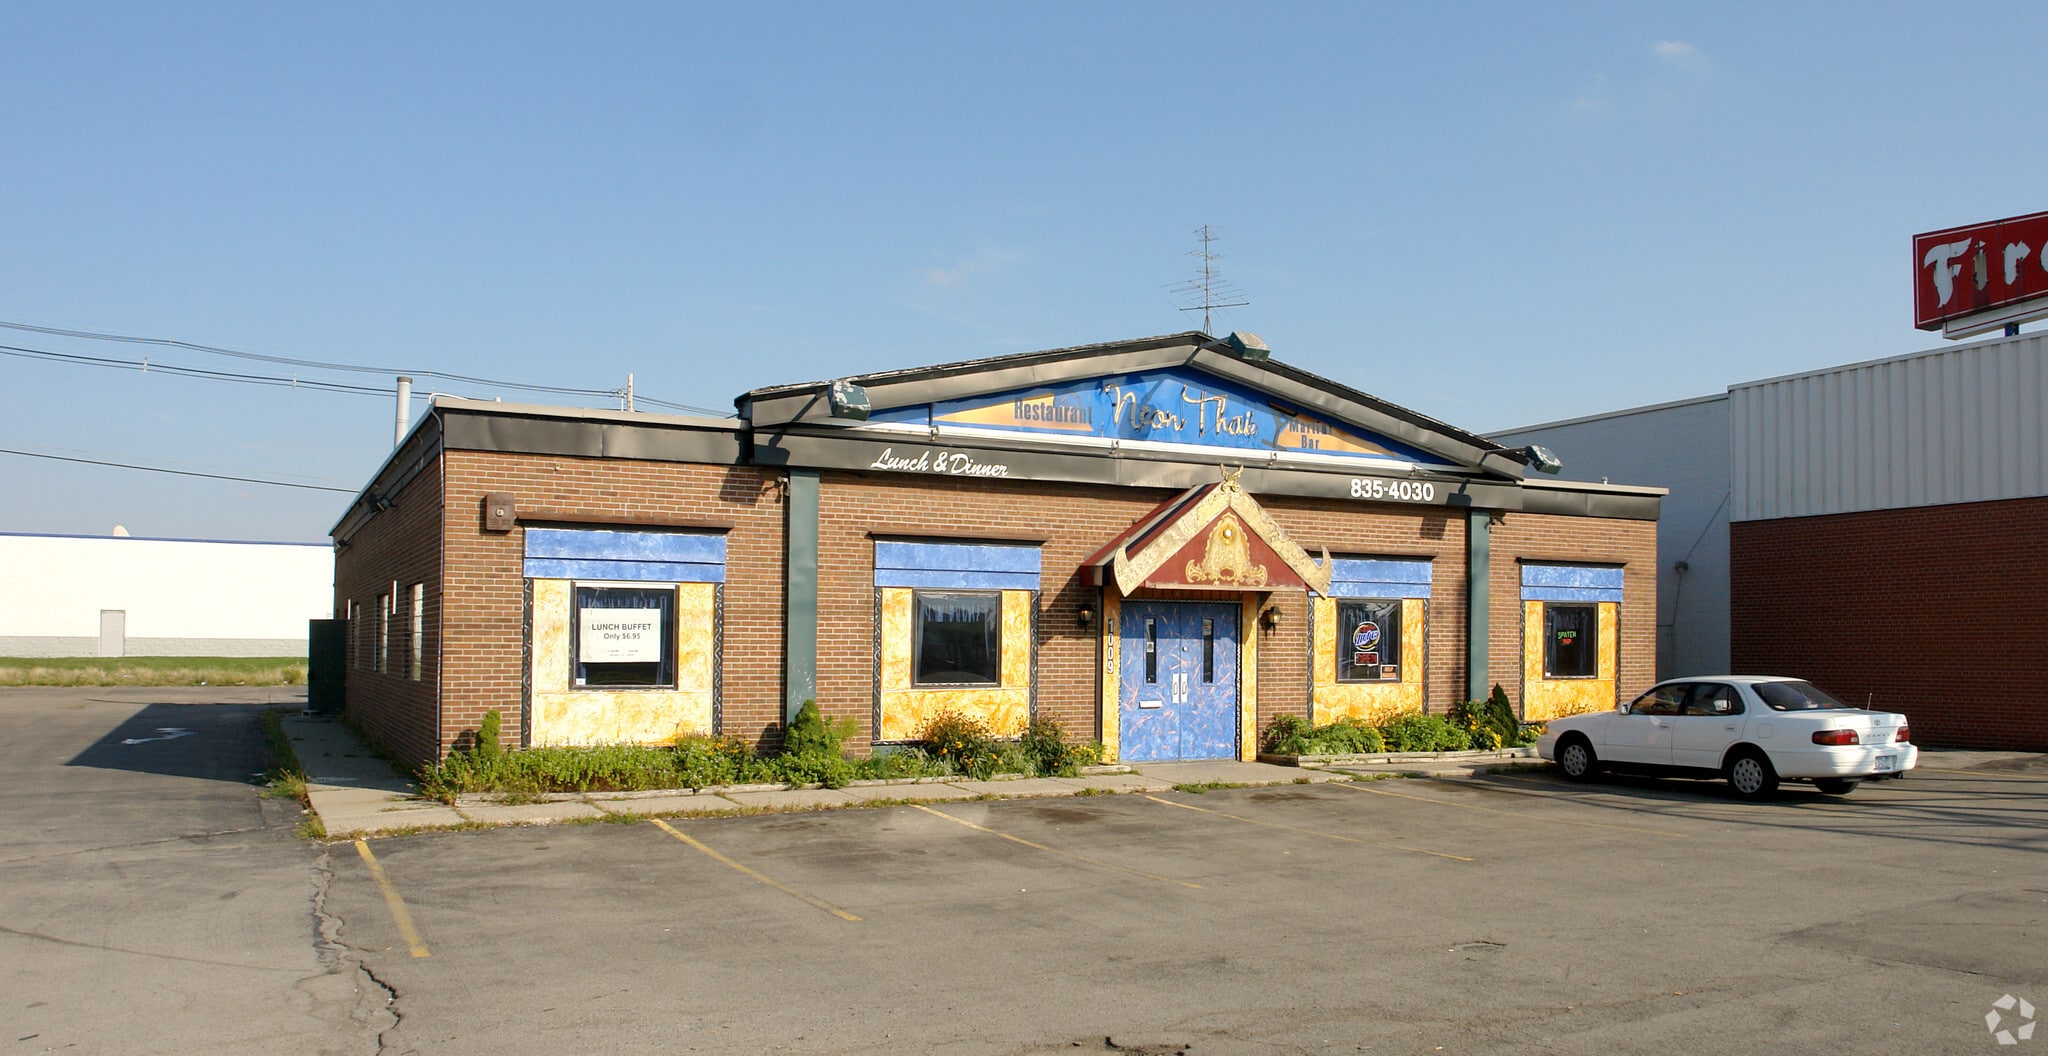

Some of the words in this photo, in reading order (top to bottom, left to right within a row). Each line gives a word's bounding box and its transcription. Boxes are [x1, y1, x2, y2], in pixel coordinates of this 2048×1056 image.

[1923, 236, 2048, 309] Fir
[1014, 398, 1092, 425] Restaurant
[1104, 383, 1187, 432] Neon
[1181, 384, 1259, 437] Thai
[1301, 434, 1320, 450] Bar
[871, 447, 930, 472] Lunch
[932, 451, 949, 473] &
[949, 453, 1009, 477] Dinner
[1350, 478, 1435, 501] 835-4030
[591, 623, 620, 631] LUNCH
[621, 623, 652, 631] BUFFET
[603, 632, 621, 641] Only
[622, 632, 641, 640] $6.95
